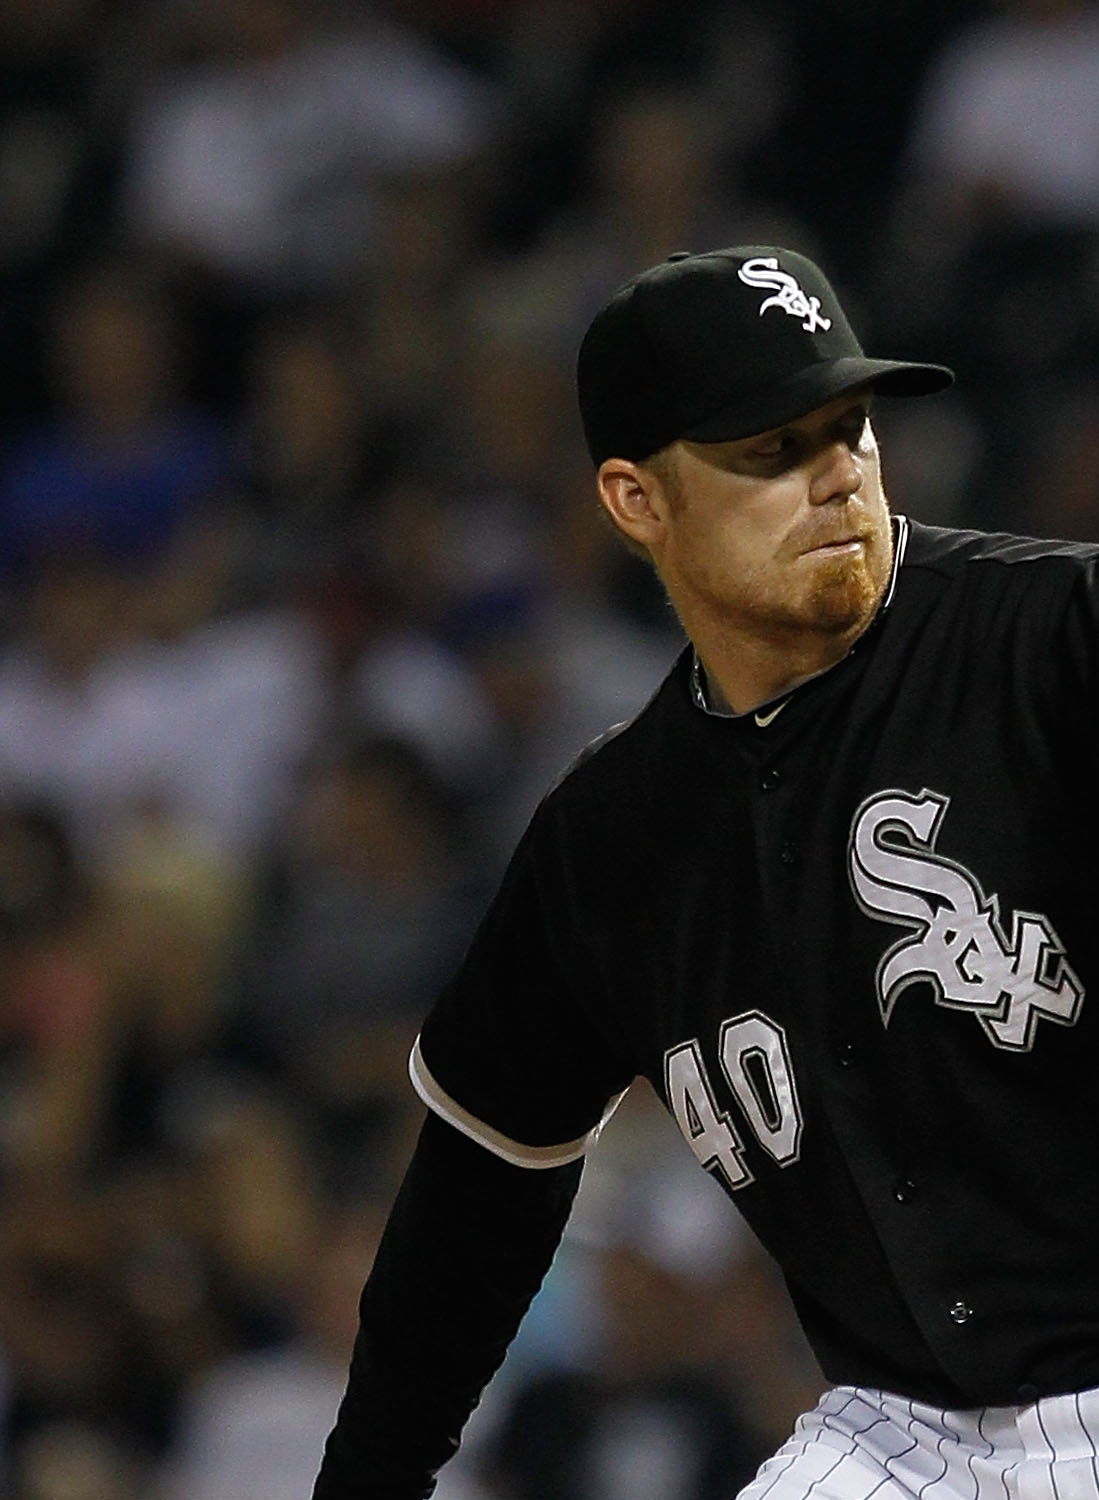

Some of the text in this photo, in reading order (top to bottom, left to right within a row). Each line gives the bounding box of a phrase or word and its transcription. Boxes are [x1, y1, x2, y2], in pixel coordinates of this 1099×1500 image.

[738, 257, 831, 333] Sox
[847, 788, 1086, 1053] Sox
[664, 1009, 803, 1191] 40
